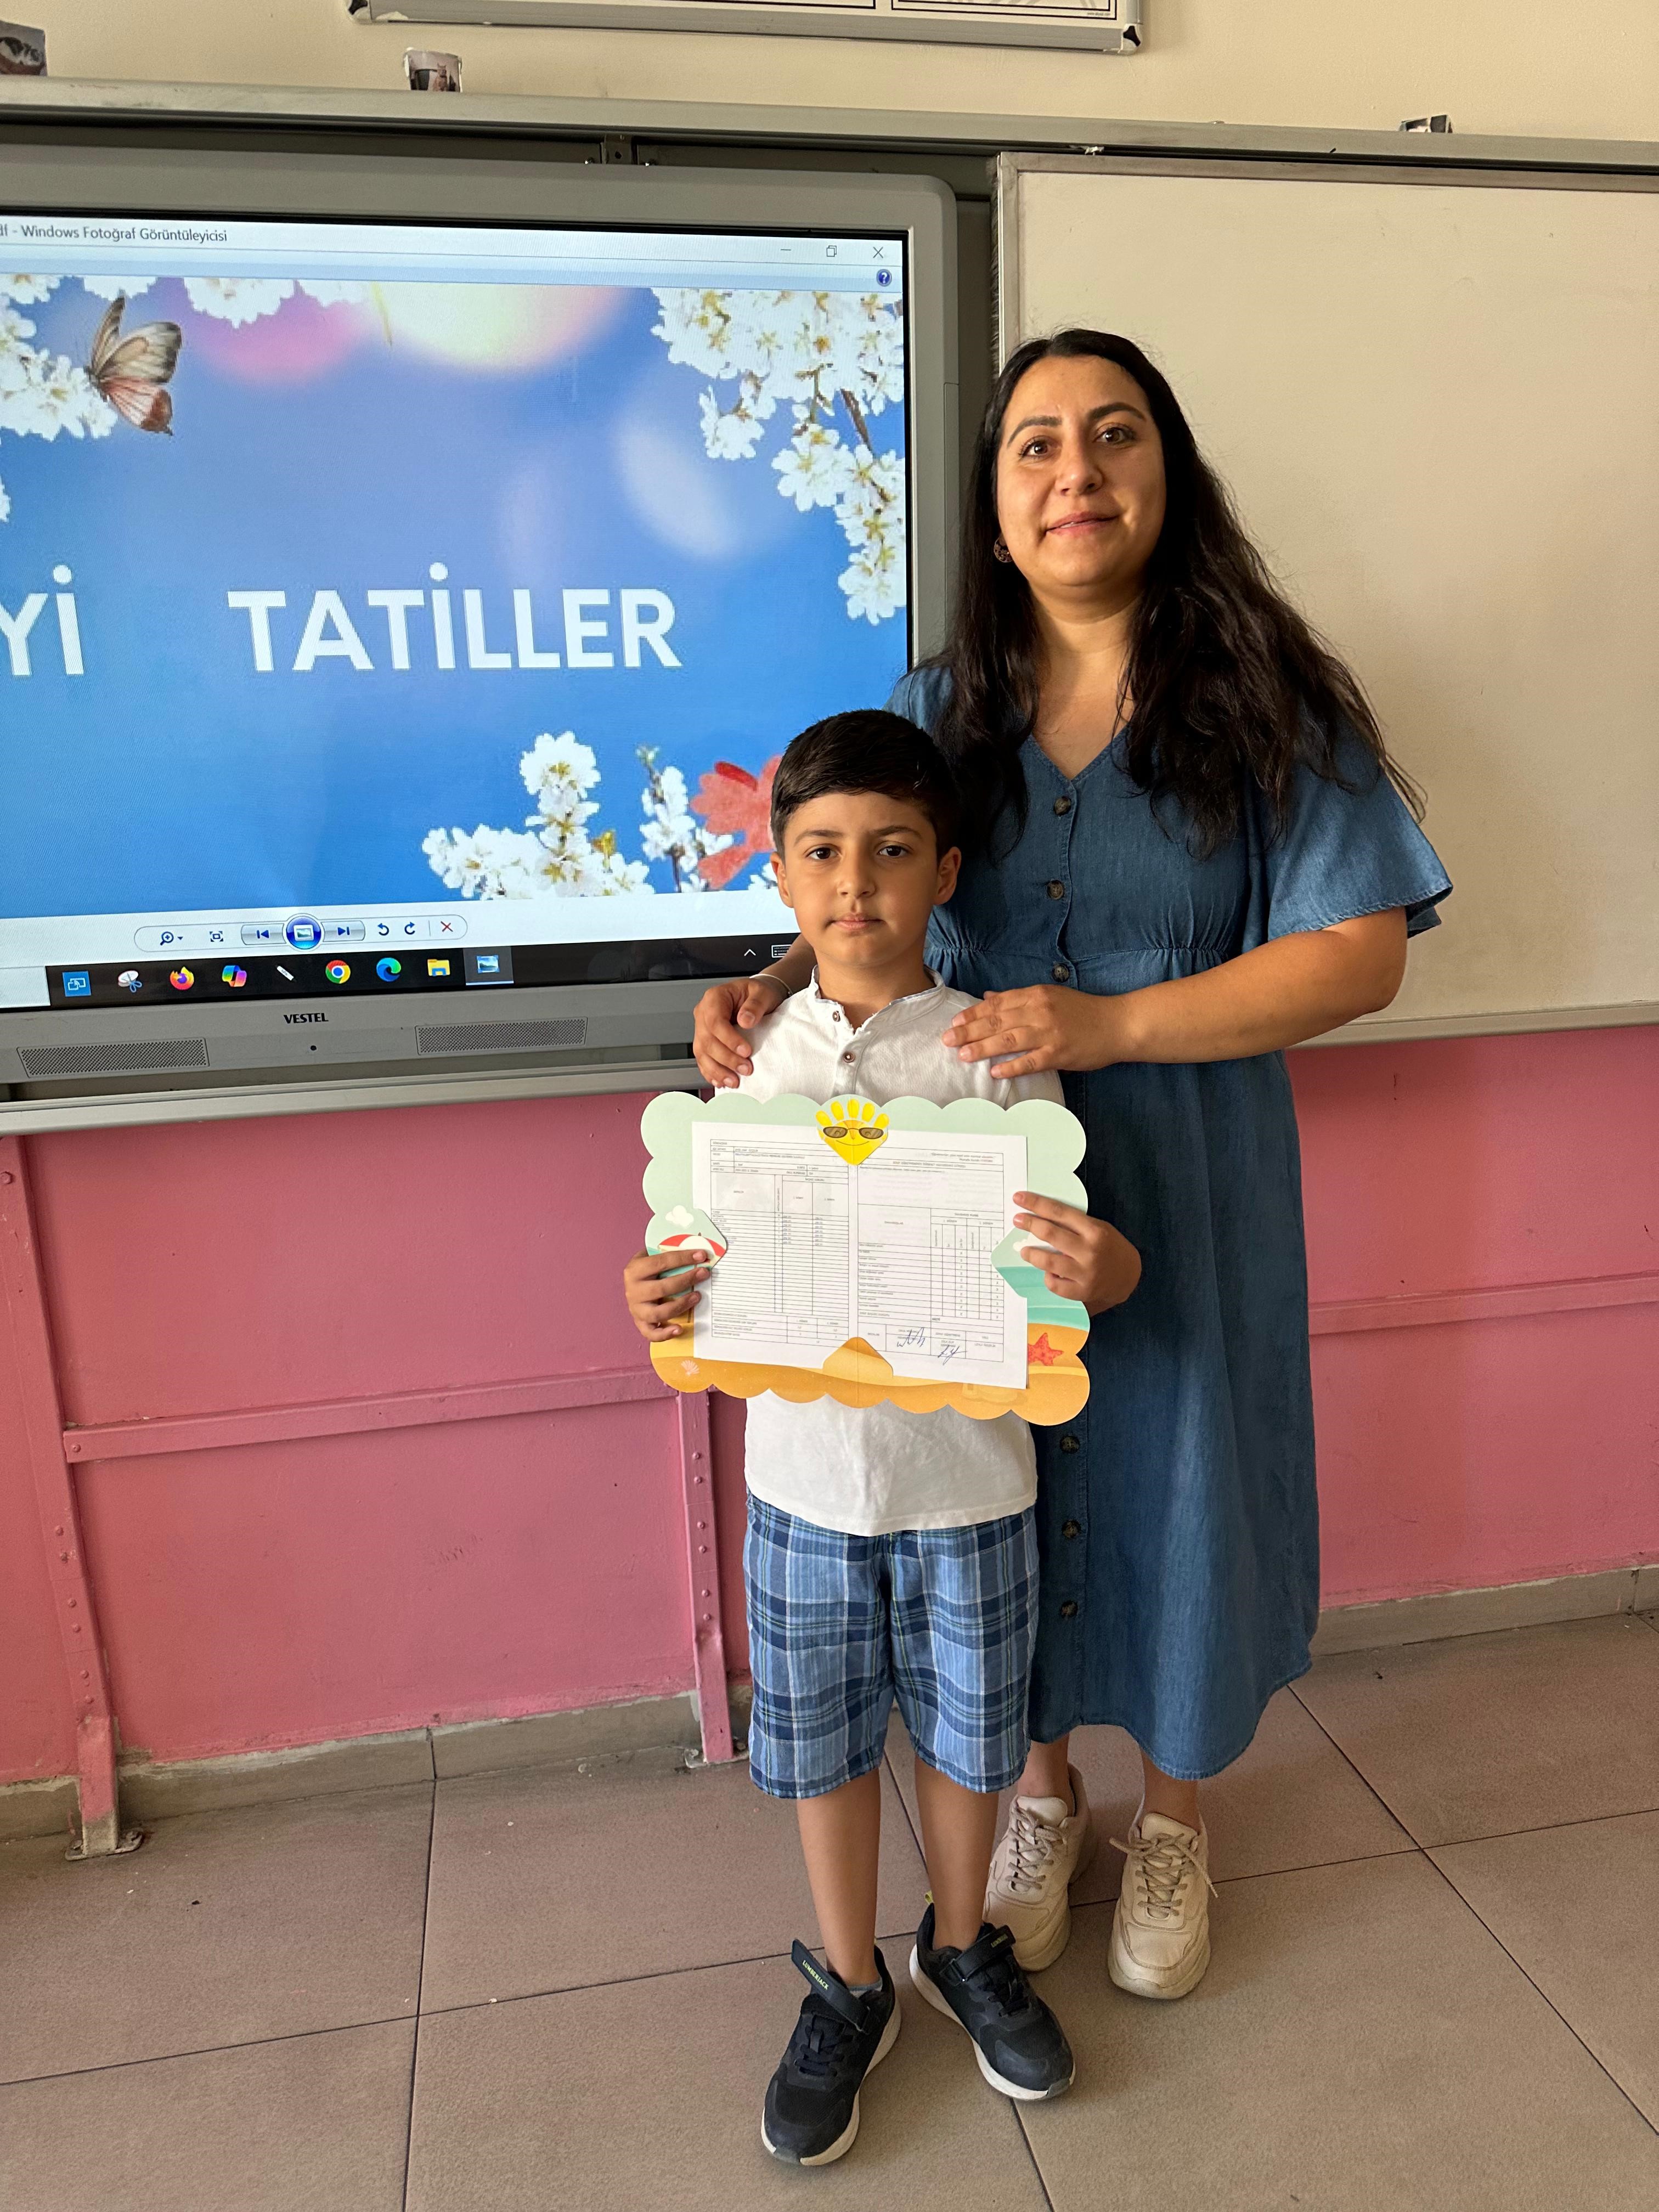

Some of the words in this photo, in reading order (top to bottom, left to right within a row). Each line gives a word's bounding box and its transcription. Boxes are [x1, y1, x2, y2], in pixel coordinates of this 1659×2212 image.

[21, 224, 79, 238] Windows
[83, 226, 136, 242] Fotoğraf
[140, 228, 227, 244] Görüntüleyicisi
[0, 565, 84, 675] Yİ
[227, 562, 682, 672] TATİLLER
[283, 1012, 329, 1024] VESTEL
